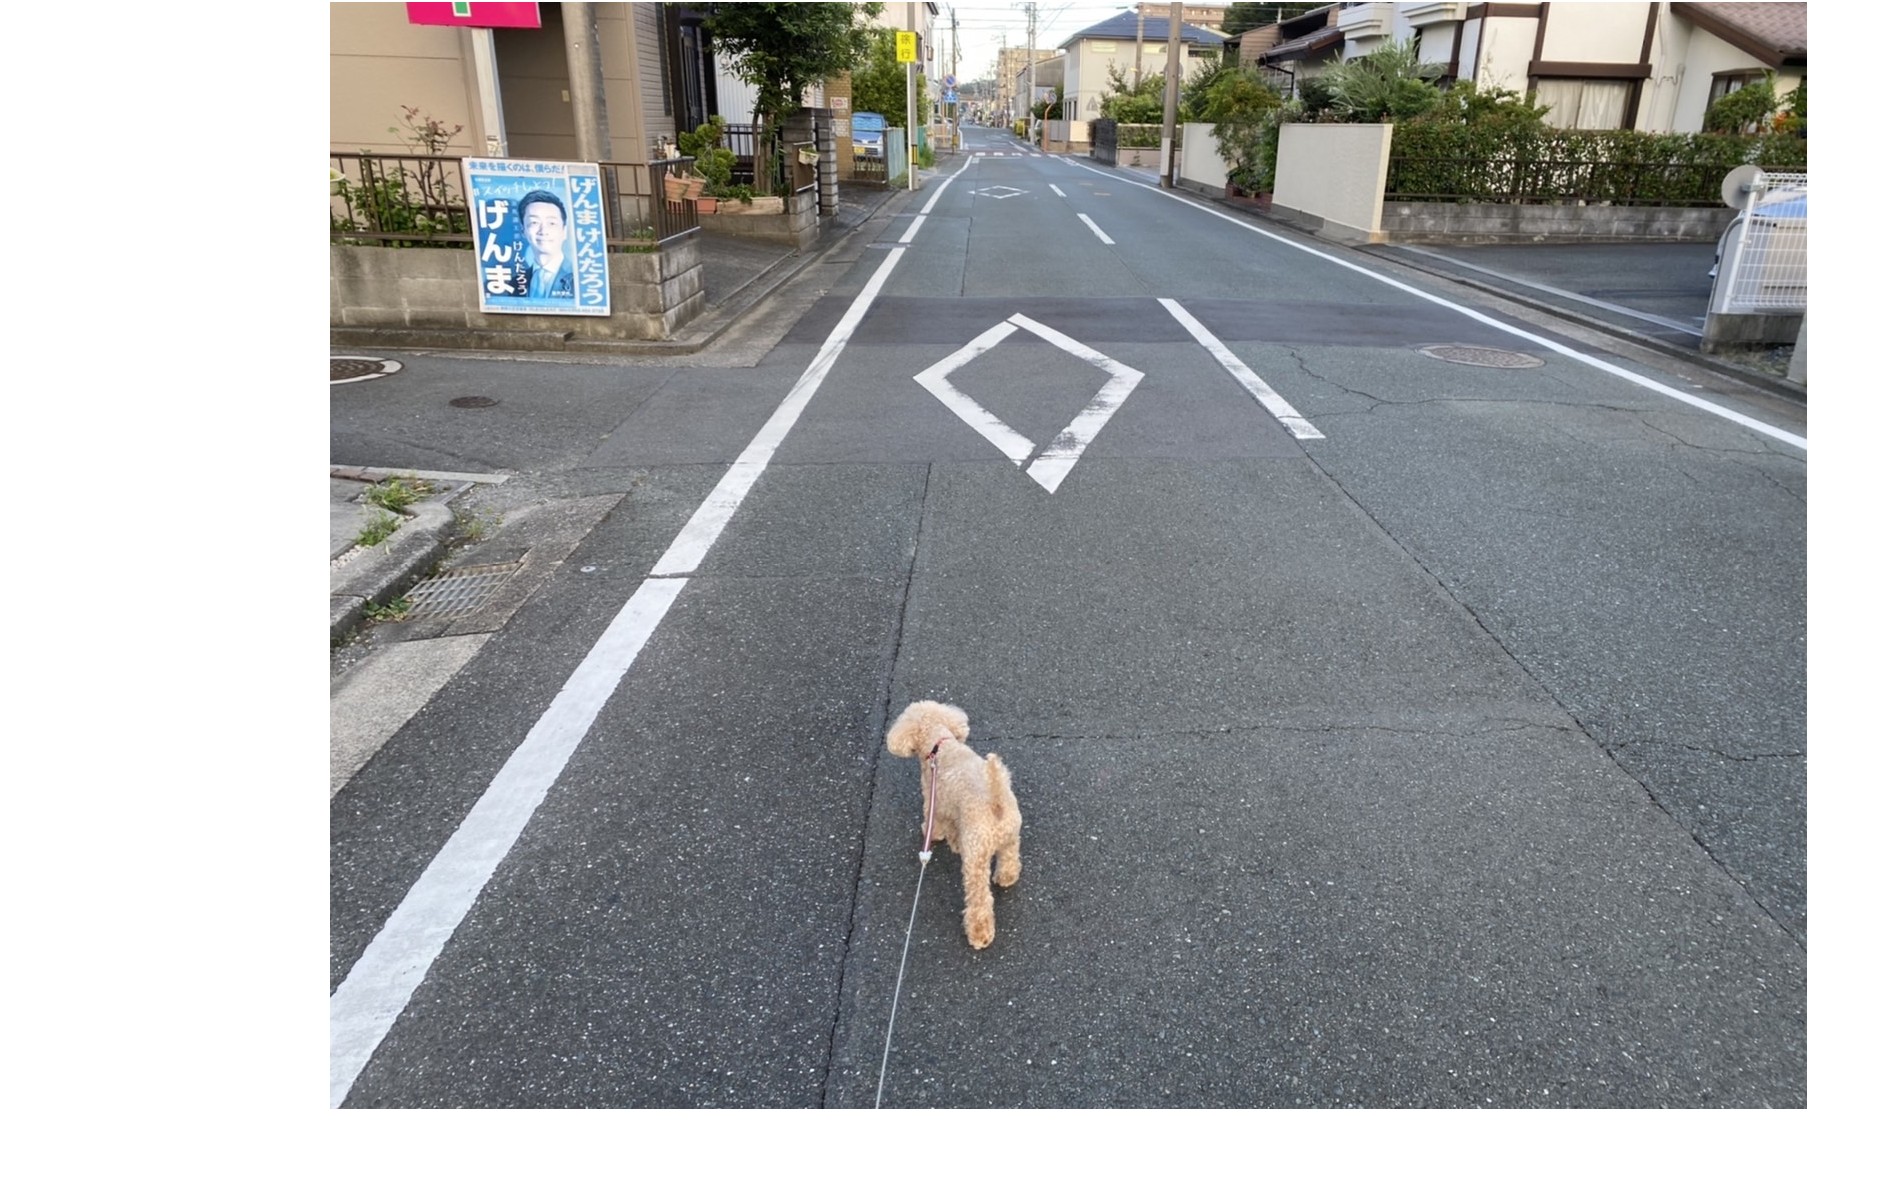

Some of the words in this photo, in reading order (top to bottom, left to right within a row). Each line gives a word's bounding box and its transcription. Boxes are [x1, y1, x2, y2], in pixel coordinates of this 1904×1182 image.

[901, 34, 911, 59] 徐行
[478, 199, 515, 295] げんま
[513, 241, 528, 296] けんたろう
